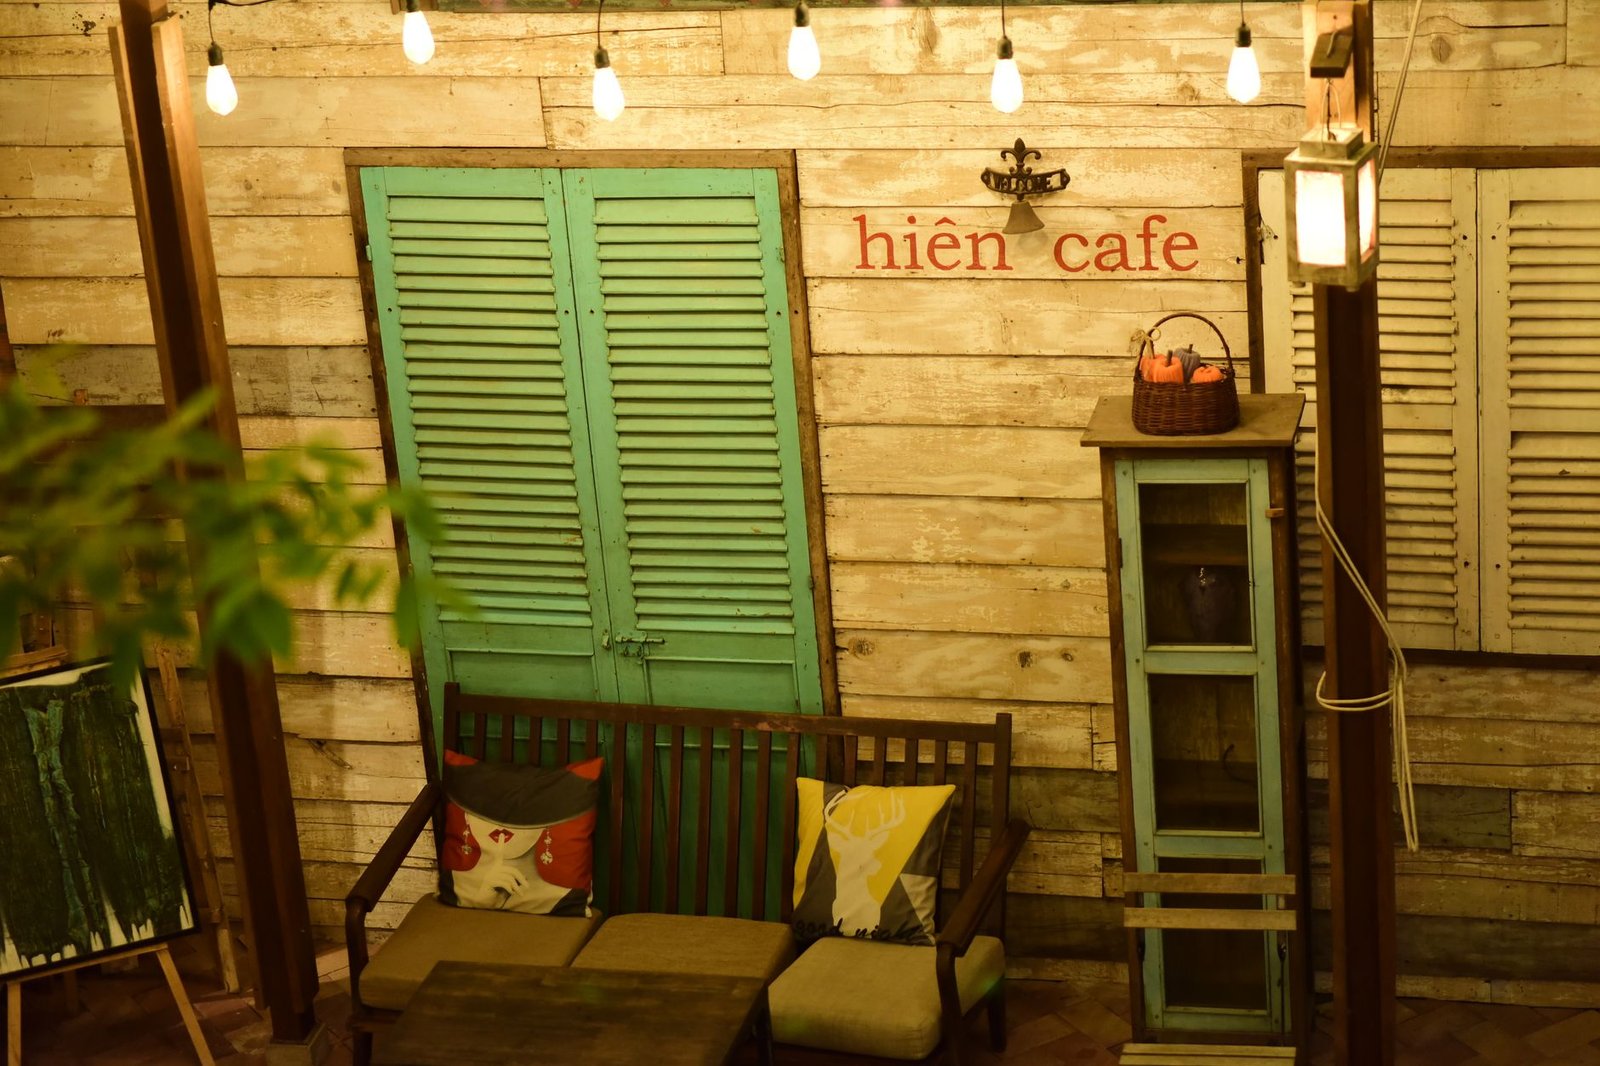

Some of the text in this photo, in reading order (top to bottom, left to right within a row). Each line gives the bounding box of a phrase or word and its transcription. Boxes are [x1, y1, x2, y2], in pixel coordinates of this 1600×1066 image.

[990, 172, 1053, 193] WELCOME
[853, 213, 1200, 273] hiên cafe
